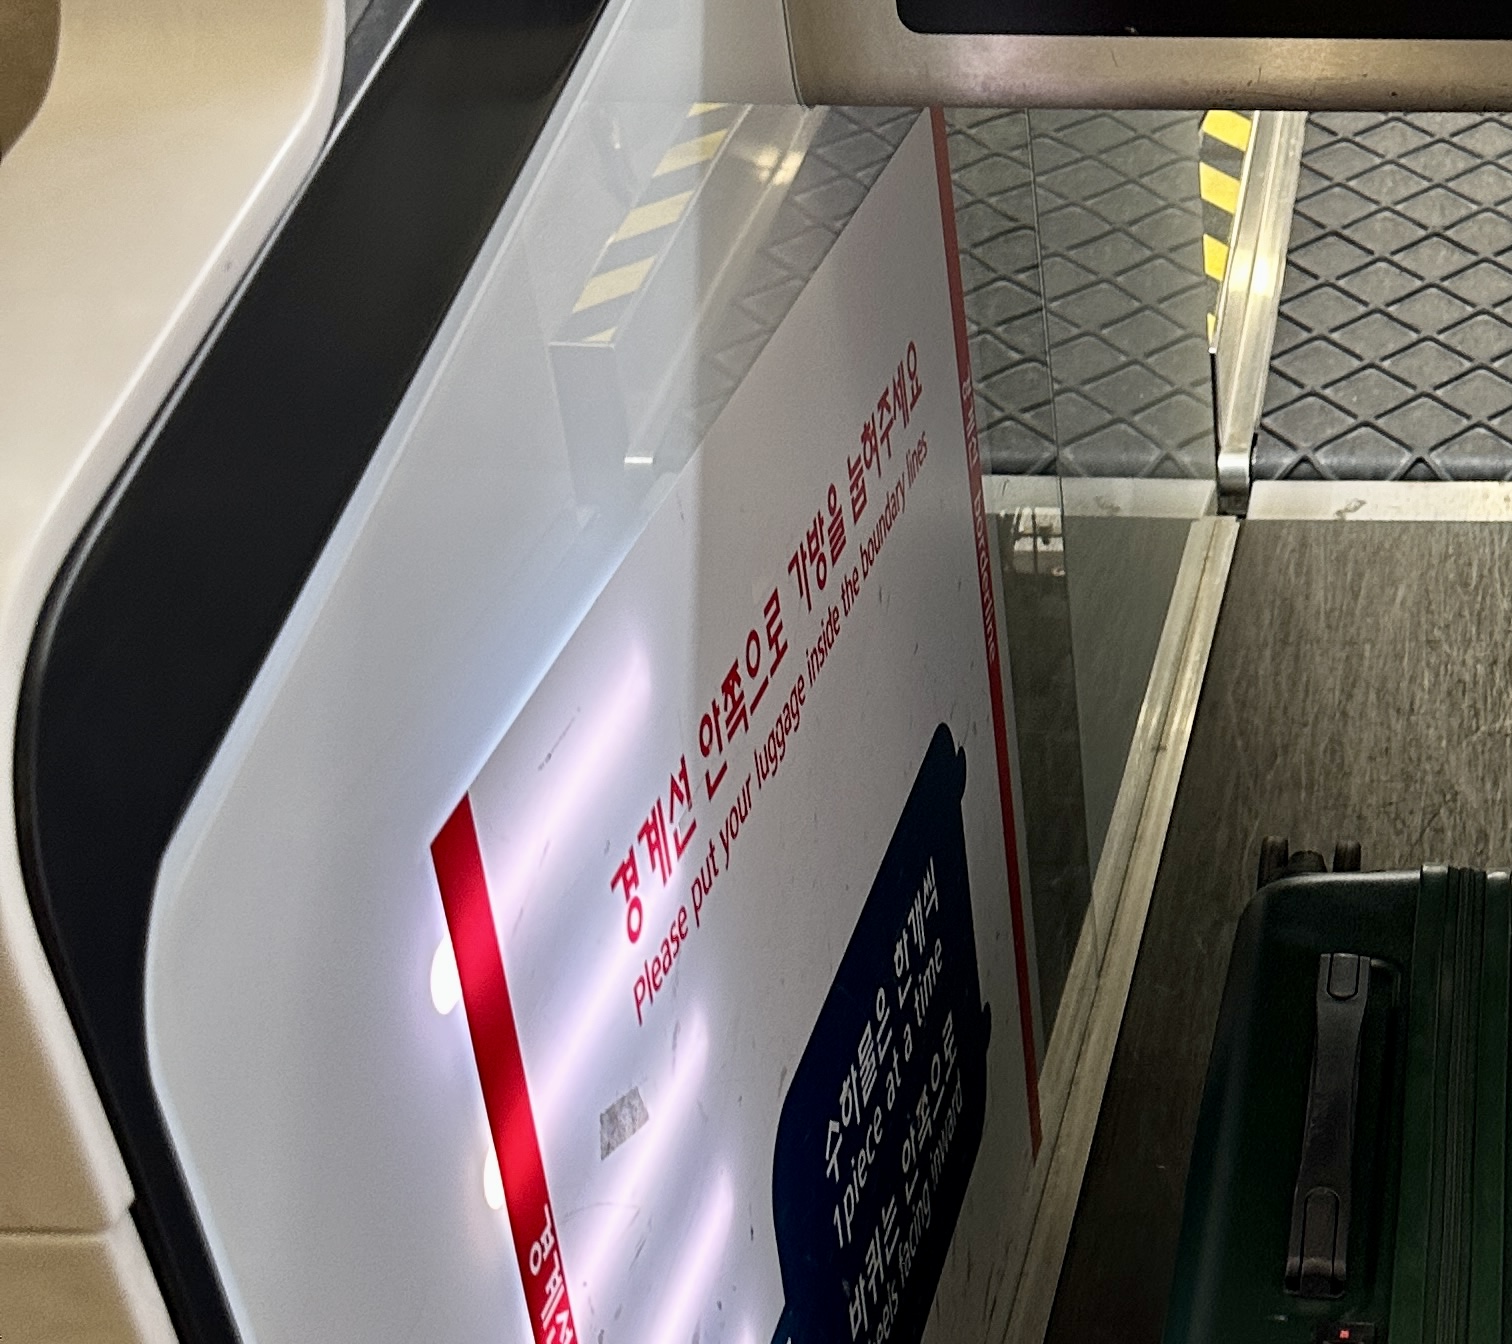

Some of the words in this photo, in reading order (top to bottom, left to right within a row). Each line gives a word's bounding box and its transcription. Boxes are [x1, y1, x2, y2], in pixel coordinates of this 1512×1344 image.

[610, 753, 697, 944] 경계선
[700, 587, 788, 801] 안쪽으로
[787, 482, 847, 613] 가방을
[847, 340, 922, 526] 눕혀주세요
[632, 905, 689, 1027] Please
[690, 838, 720, 929] put
[719, 772, 752, 871] your
[754, 673, 806, 790] luggage
[805, 605, 840, 688] inside
[840, 565, 860, 618] the
[859, 472, 905, 581] boundary
[906, 430, 929, 490] lines
[975, 489, 996, 665] borderline
[826, 987, 892, 1183] 수하물은
[893, 856, 939, 1009] 한개씩
[848, 1194, 900, 1342] 바퀴는
[902, 1009, 957, 1205] 안쪽으로
[885, 1046, 901, 1111] at
[903, 1023, 913, 1062] a
[914, 937, 942, 1027] time
[898, 1178, 931, 1289] facing
[930, 1067, 962, 1191] inward
